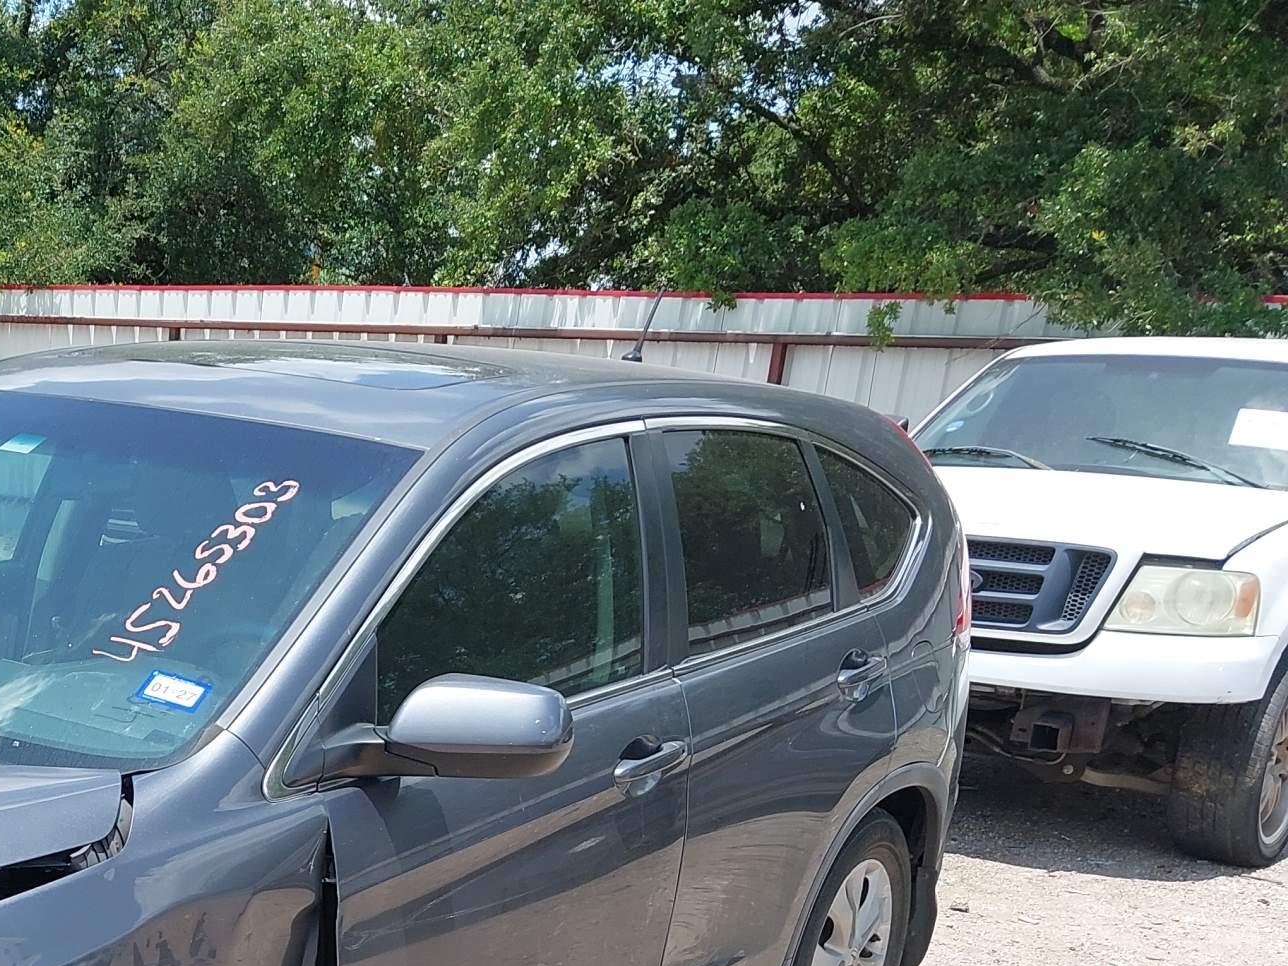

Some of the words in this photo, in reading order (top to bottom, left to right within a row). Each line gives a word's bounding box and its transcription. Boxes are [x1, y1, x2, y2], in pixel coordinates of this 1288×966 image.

[92, 479, 300, 662] 45265303
[151, 682, 170, 694] 01
[175, 689, 198, 701] 27
